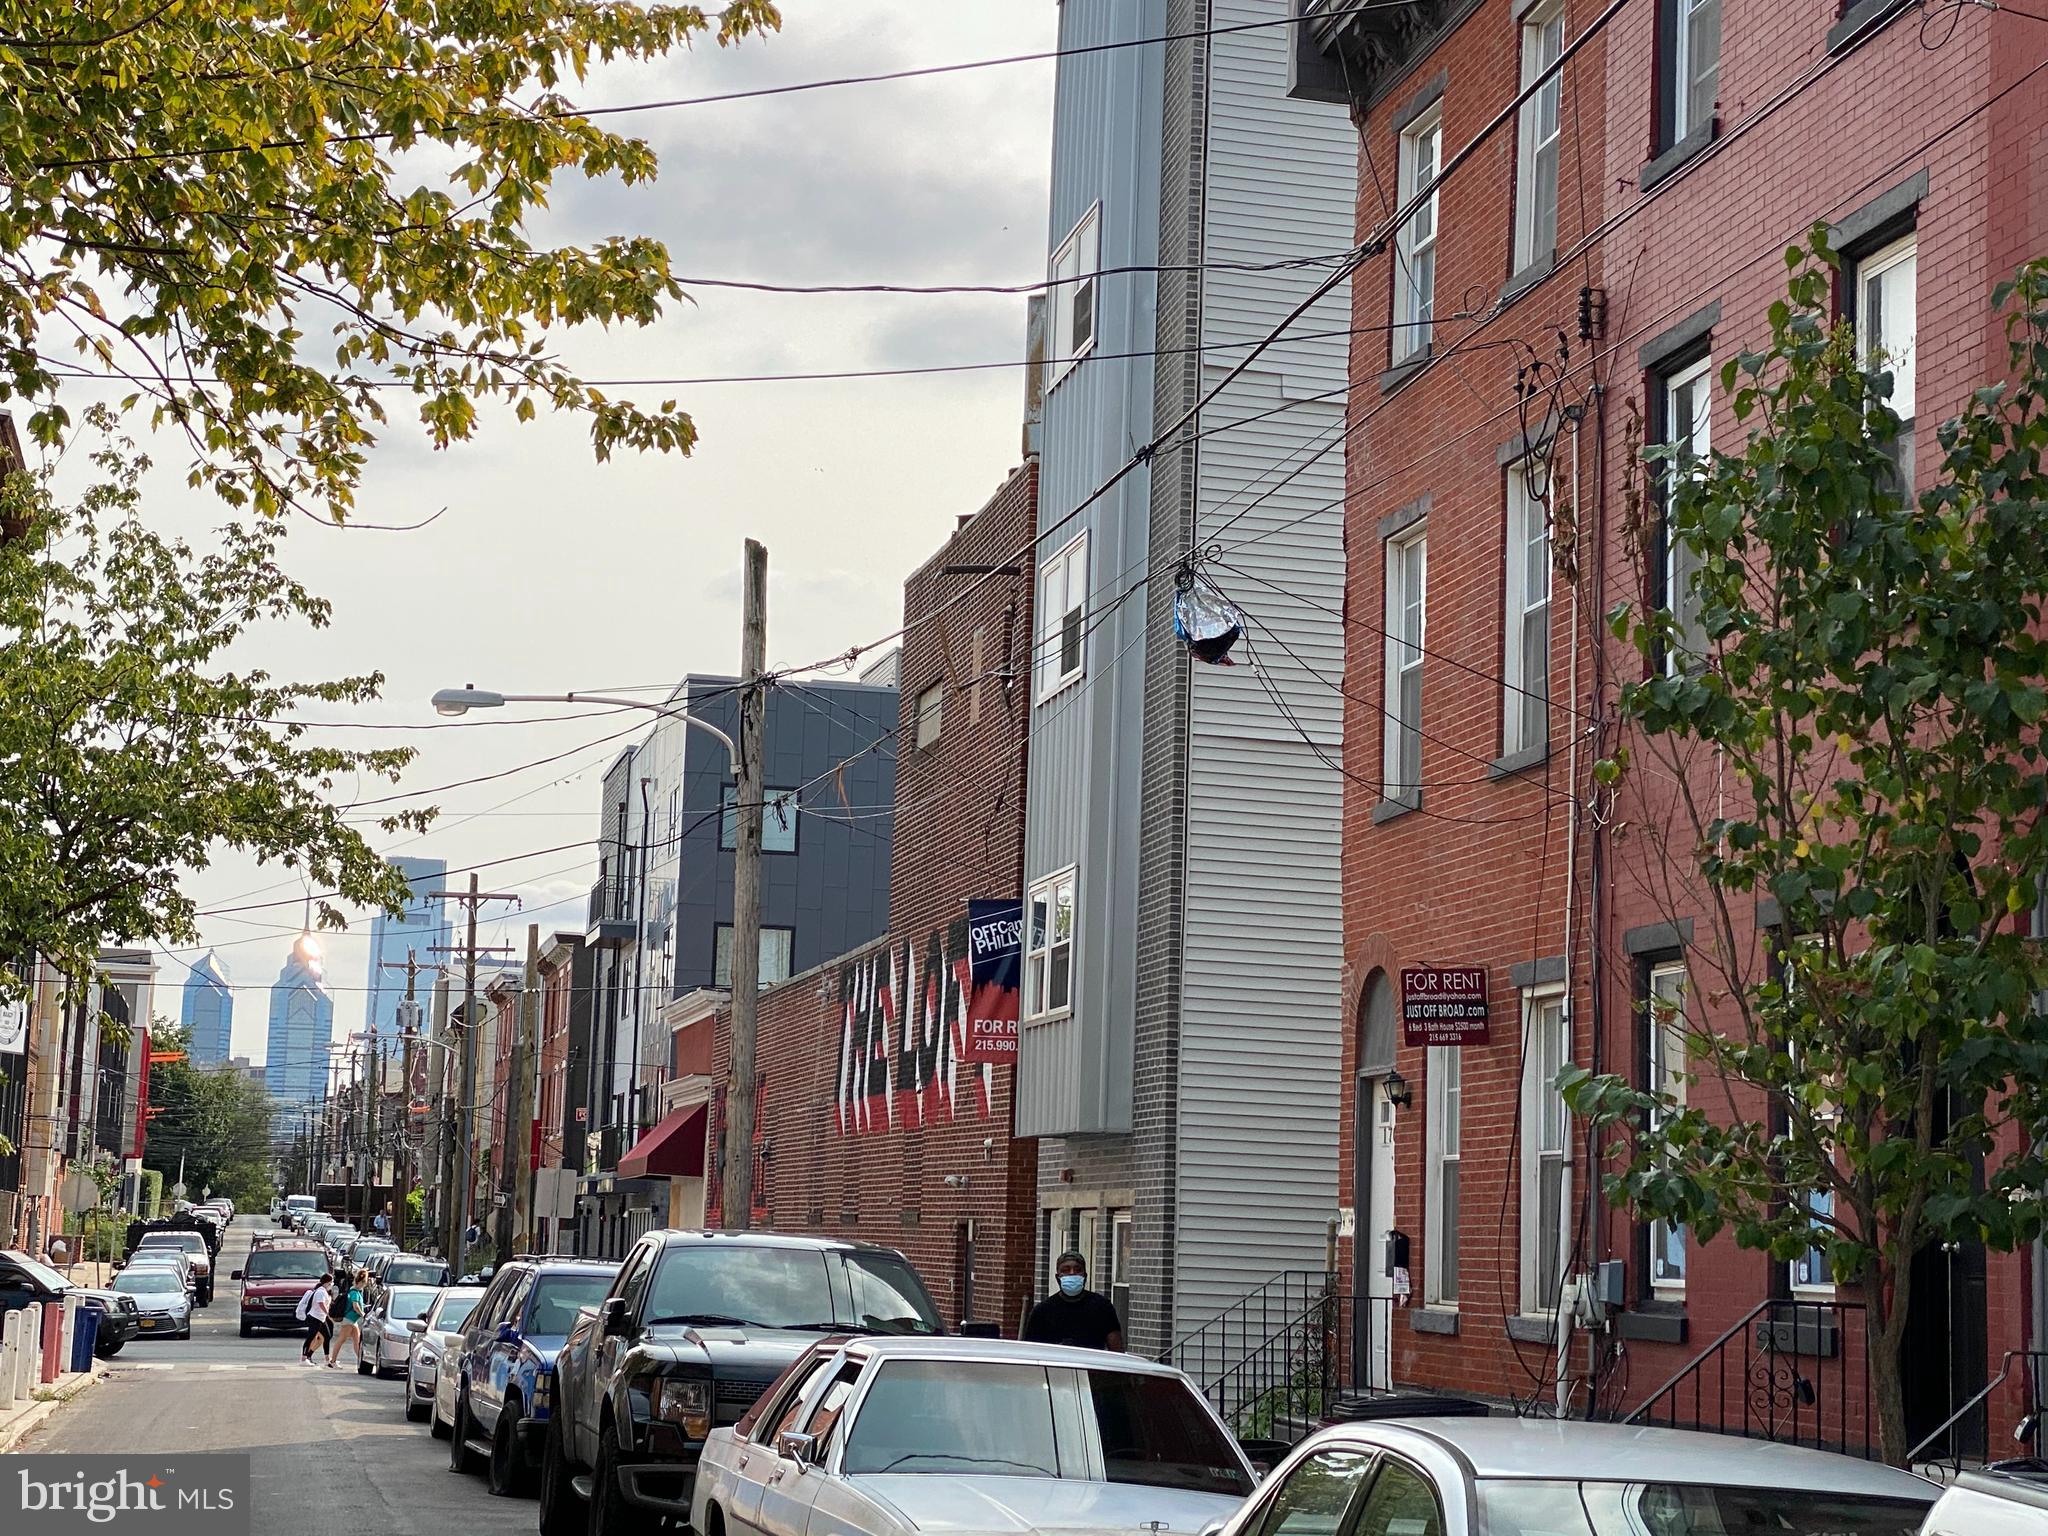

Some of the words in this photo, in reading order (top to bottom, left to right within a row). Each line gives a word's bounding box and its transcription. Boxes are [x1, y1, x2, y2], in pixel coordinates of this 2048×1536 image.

[975, 929, 1022, 954] PHILLY
[1405, 973, 1438, 991] FOR
[1443, 972, 1481, 990] RENT
[1406, 1004, 1421, 1018] JUST
[1422, 1004, 1437, 1018] OFF
[1438, 1004, 1465, 1017] BROAD
[974, 1019, 1003, 1033] FOR
[1429, 1033, 1438, 1042] 215
